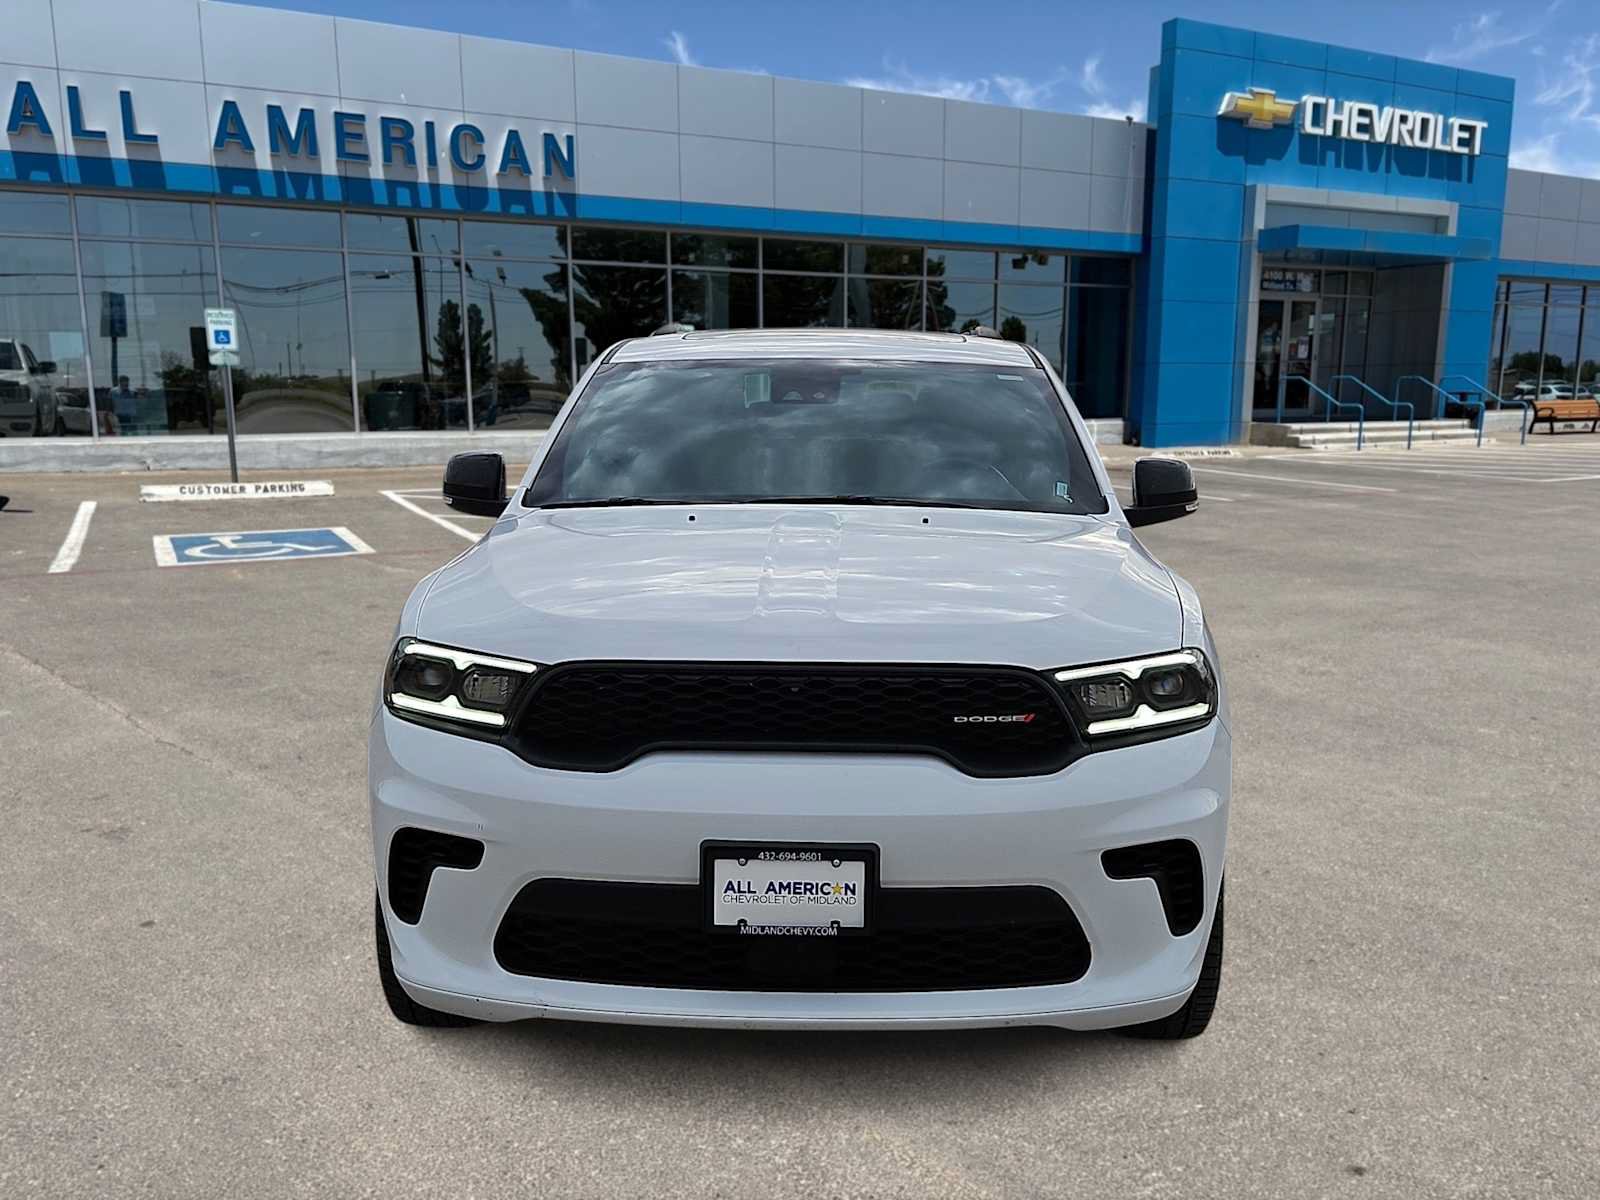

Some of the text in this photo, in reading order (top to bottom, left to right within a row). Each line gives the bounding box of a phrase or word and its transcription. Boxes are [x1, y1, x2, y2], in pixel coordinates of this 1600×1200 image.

[6, 80, 576, 178] ALL AMERICAN
[1301, 94, 1488, 156] CHEVROLET
[179, 484, 305, 495] CUSTOMER PARKING
[954, 715, 1026, 723] DODGE
[758, 852, 821, 861] 432-694-9601
[723, 880, 857, 896] ALL AMERICN
[722, 894, 857, 905] CHEVROLET OF MIDLAND
[740, 926, 838, 936] MIDLANDCHEVY.COM
